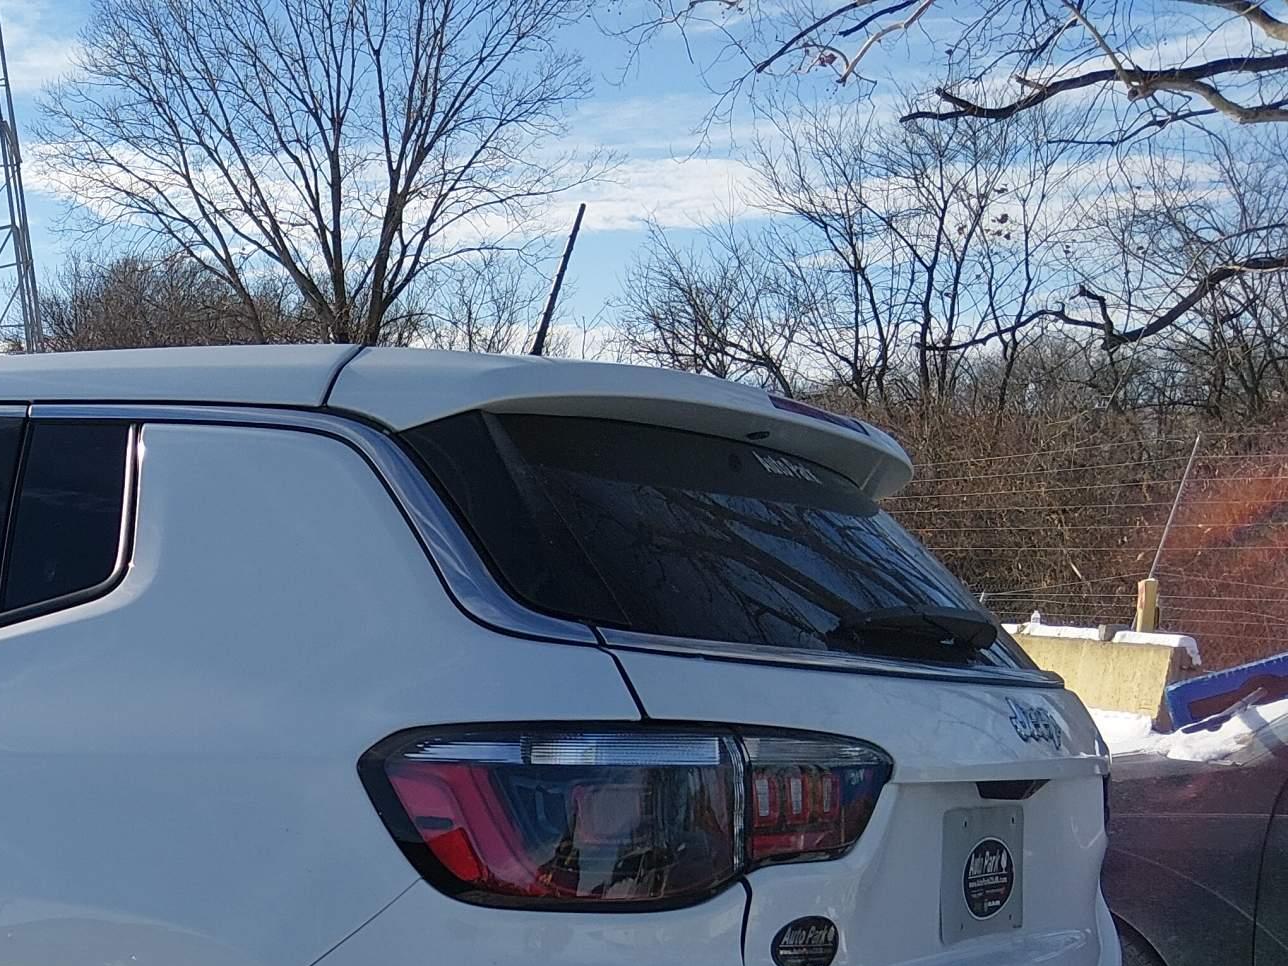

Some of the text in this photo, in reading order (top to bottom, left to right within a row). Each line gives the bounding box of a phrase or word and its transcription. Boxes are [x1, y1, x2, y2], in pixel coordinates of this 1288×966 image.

[1005, 696, 1062, 751] Jeep
[781, 925, 829, 945] Auto Park
